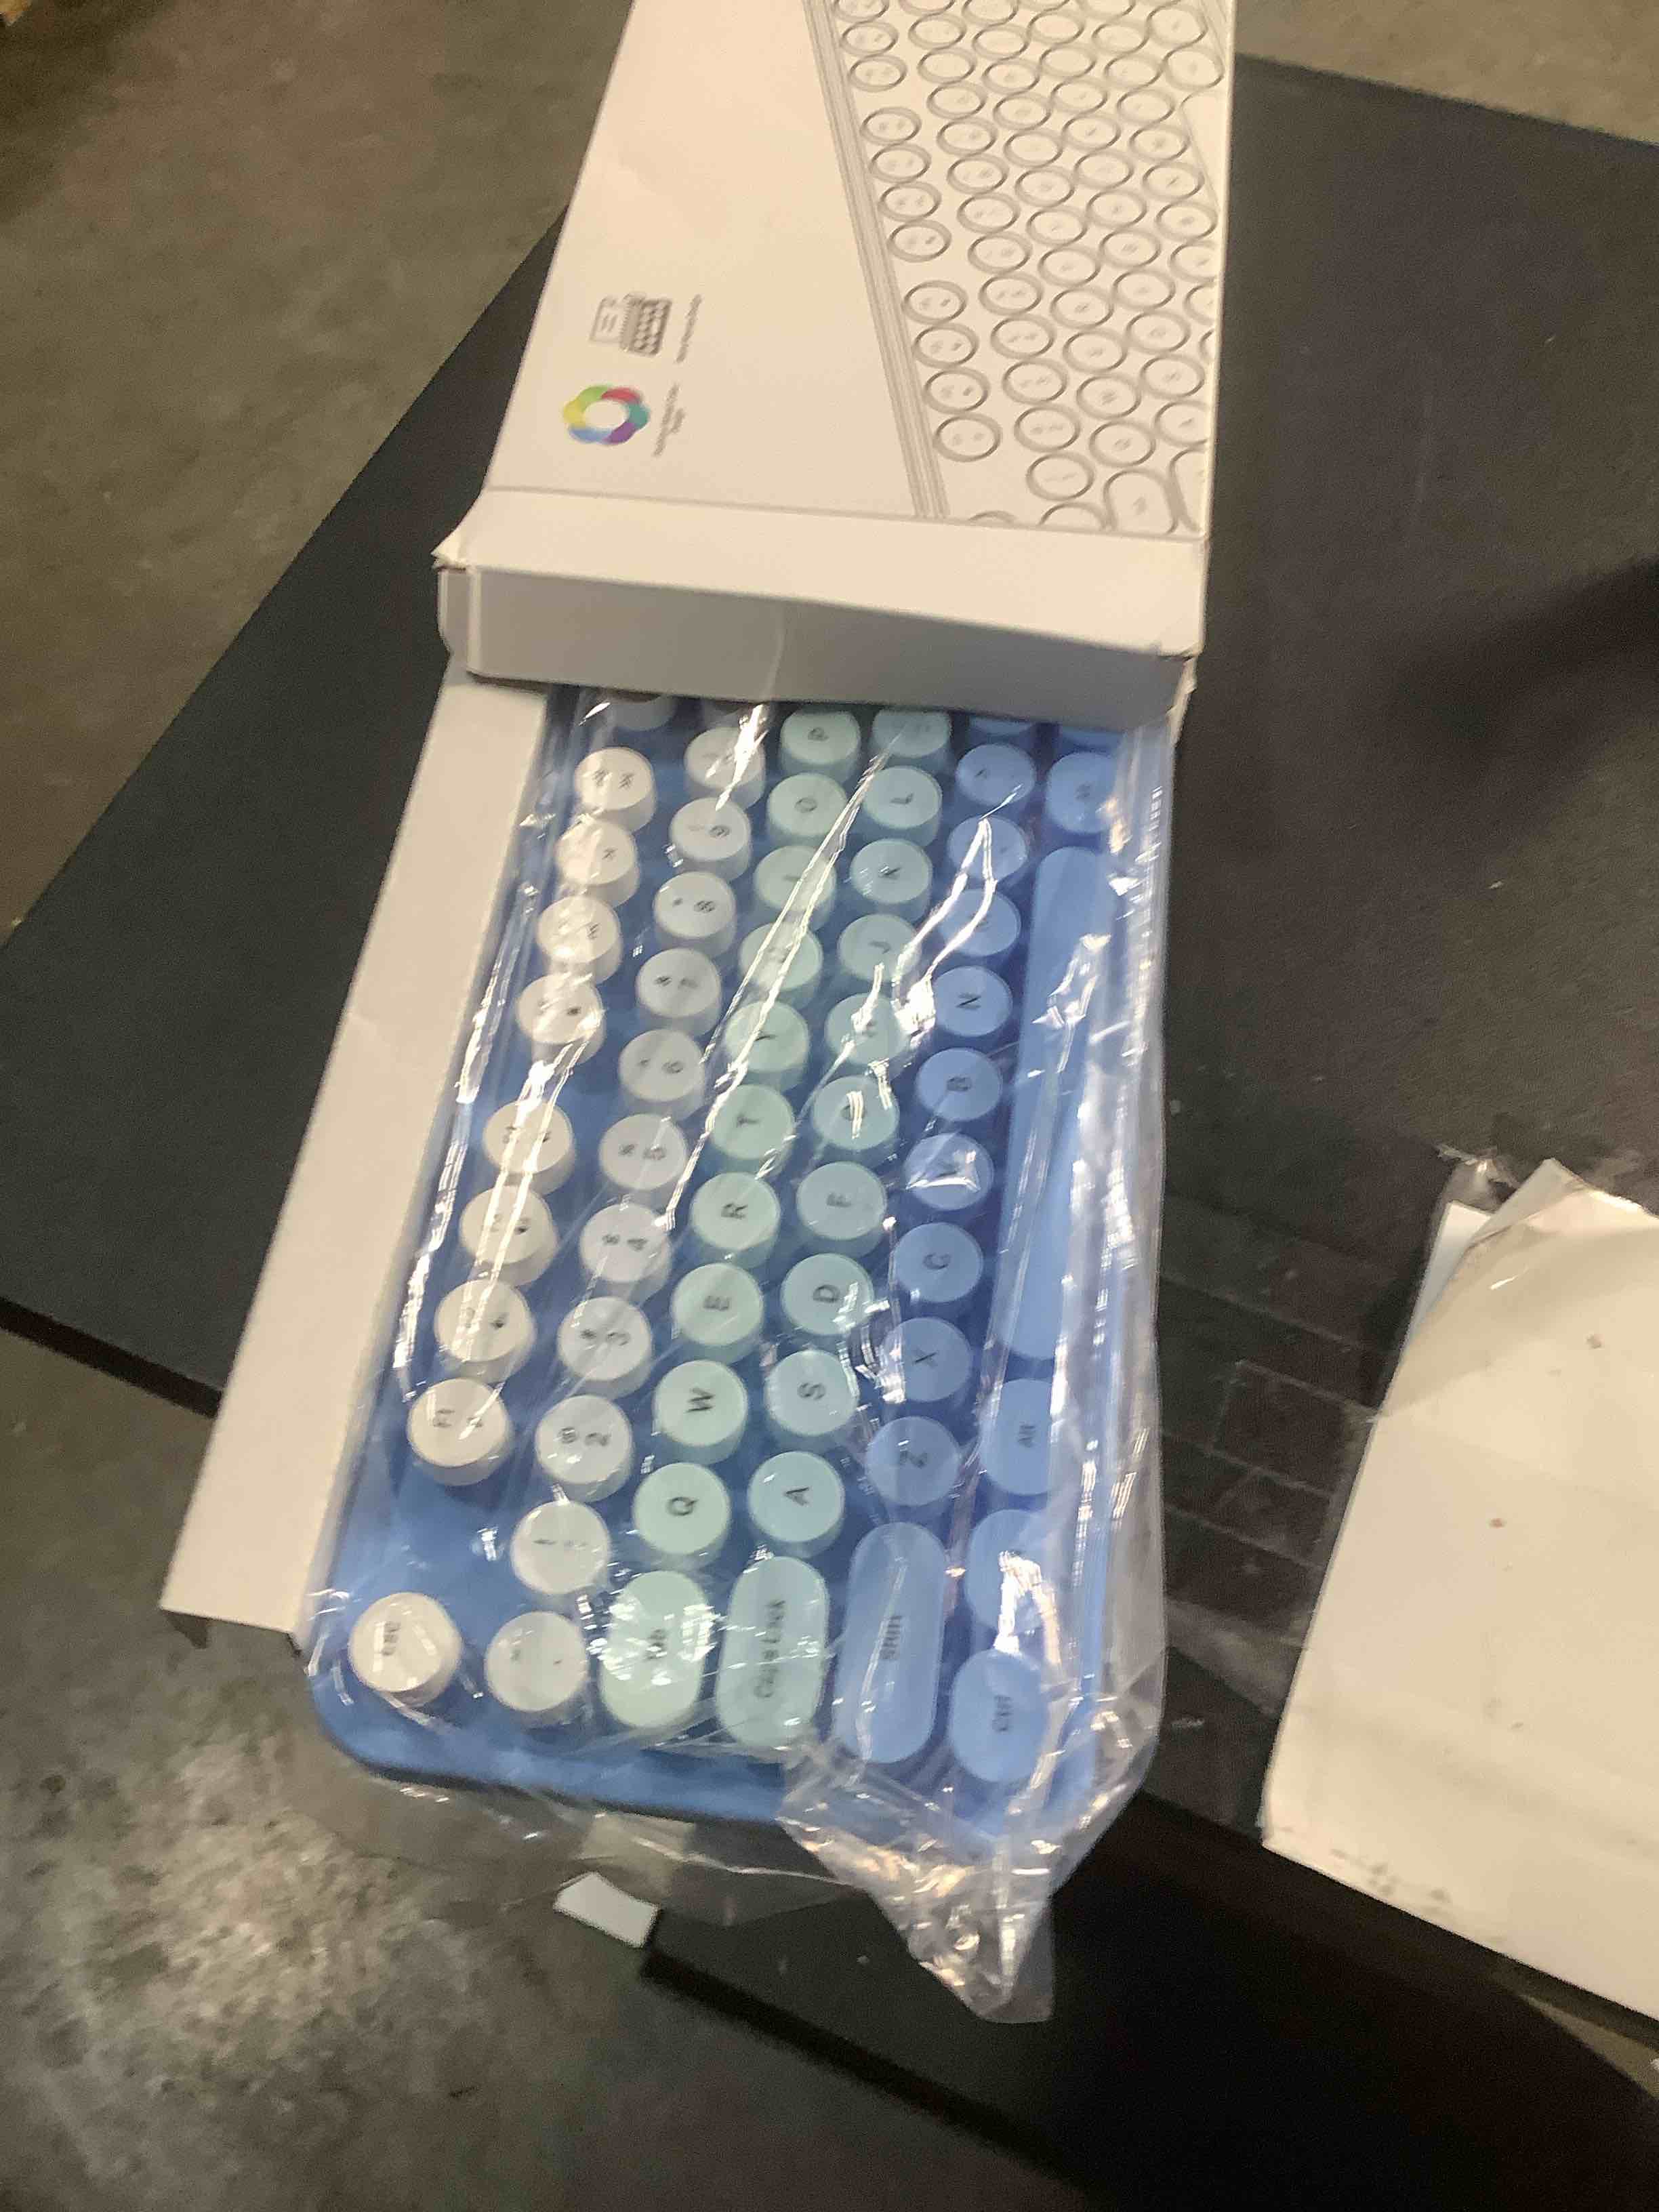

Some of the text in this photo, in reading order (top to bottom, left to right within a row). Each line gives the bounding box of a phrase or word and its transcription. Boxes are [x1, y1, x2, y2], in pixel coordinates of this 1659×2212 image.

[808, 728, 828, 741] P
[795, 798, 817, 813] O
[890, 794, 914, 804] L
[869, 941, 892, 954] J
[957, 995, 980, 1009] N
[735, 1113, 758, 1128] T
[826, 1191, 852, 1208] F
[721, 1203, 747, 1219] R
[922, 1254, 951, 1270] C
[813, 1285, 840, 1303] D
[703, 1296, 731, 1311] E
[912, 1349, 937, 1366] X
[798, 1382, 825, 1400] S
[687, 1389, 714, 1412] W
[898, 1450, 928, 1469] Z
[785, 1488, 809, 1505] A
[668, 1496, 697, 1516] Q
